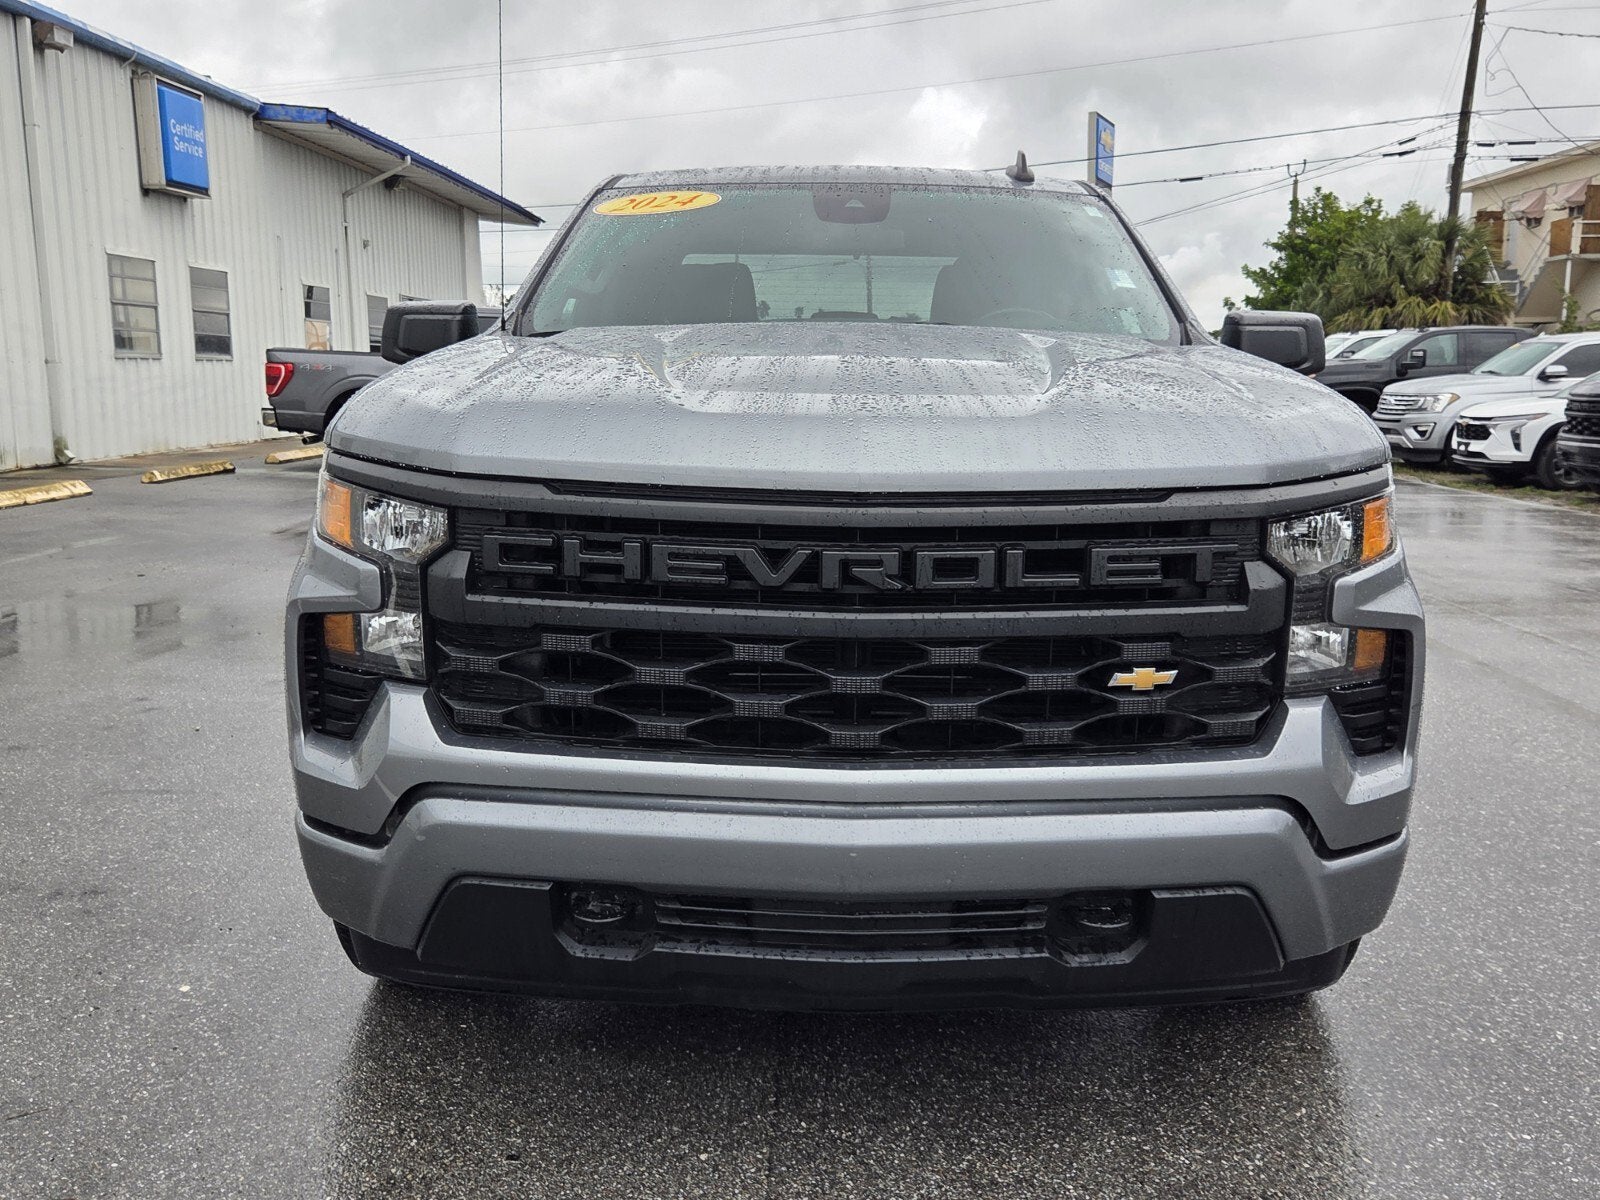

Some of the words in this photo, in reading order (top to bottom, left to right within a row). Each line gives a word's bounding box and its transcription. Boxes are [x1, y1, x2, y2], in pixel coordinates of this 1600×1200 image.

[170, 118, 204, 143] Certified
[173, 136, 204, 158] Service
[607, 193, 704, 212] 2024
[482, 534, 1239, 590] CHEVROLET
